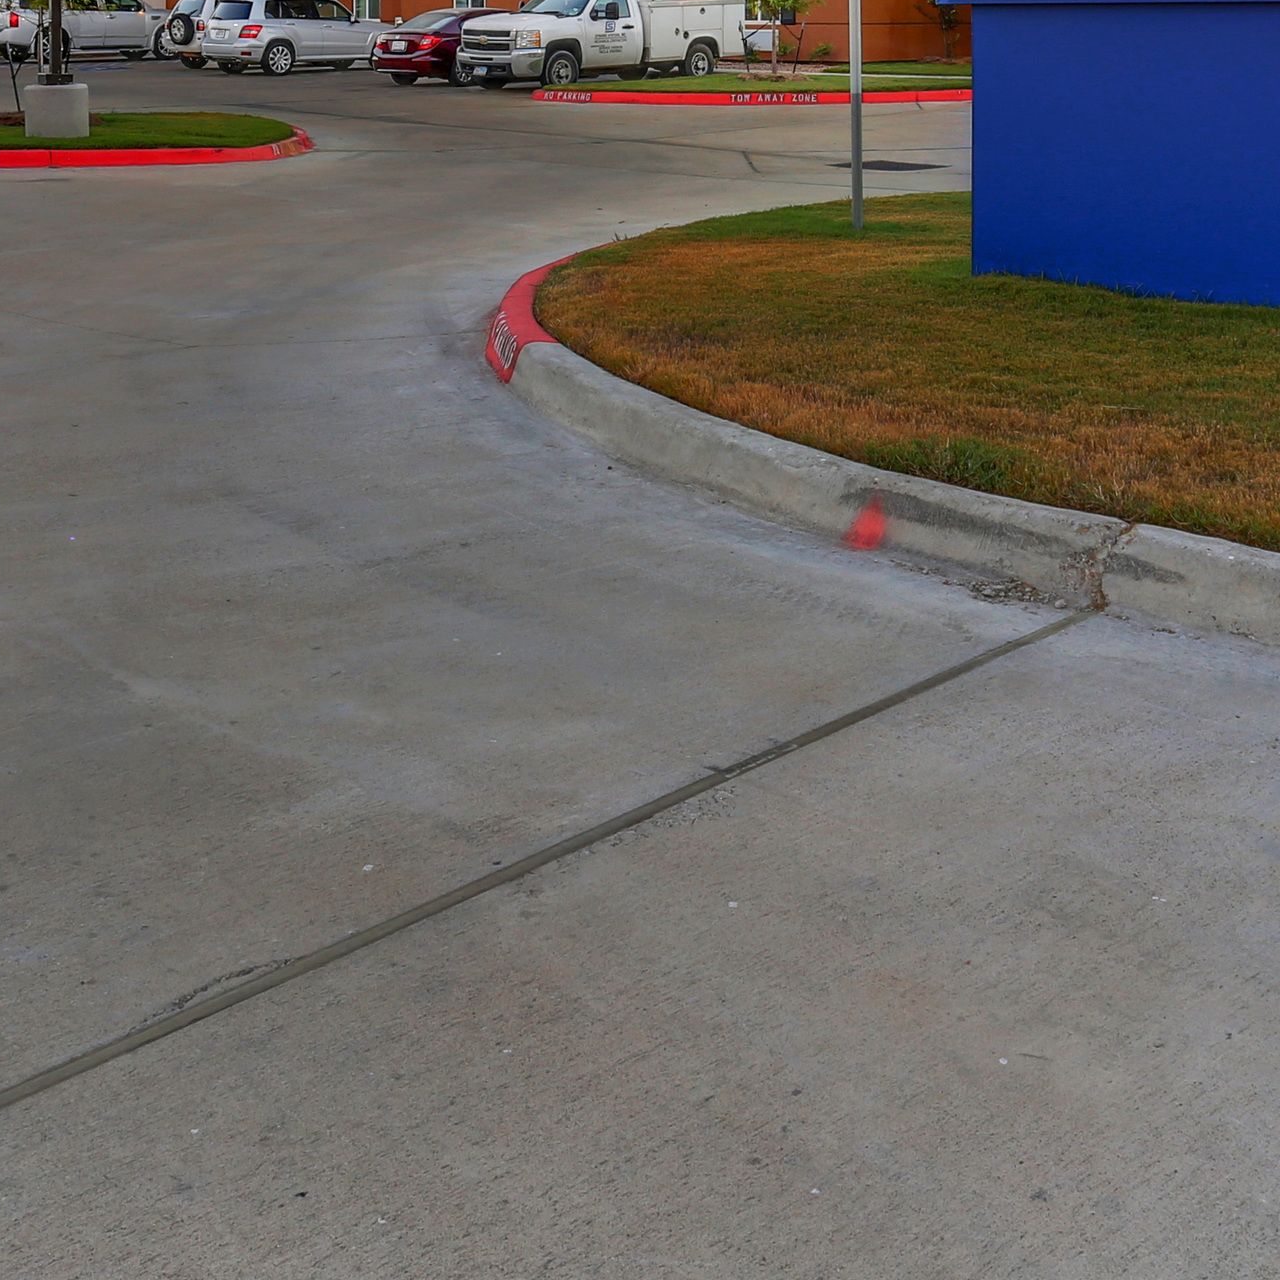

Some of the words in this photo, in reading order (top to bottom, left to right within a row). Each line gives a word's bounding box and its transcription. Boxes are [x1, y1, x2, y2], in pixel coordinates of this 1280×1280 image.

[557, 91, 592, 101] PARKING
[731, 93, 751, 103] TOW
[758, 93, 785, 102] AWAY
[792, 93, 818, 103] ZONE
